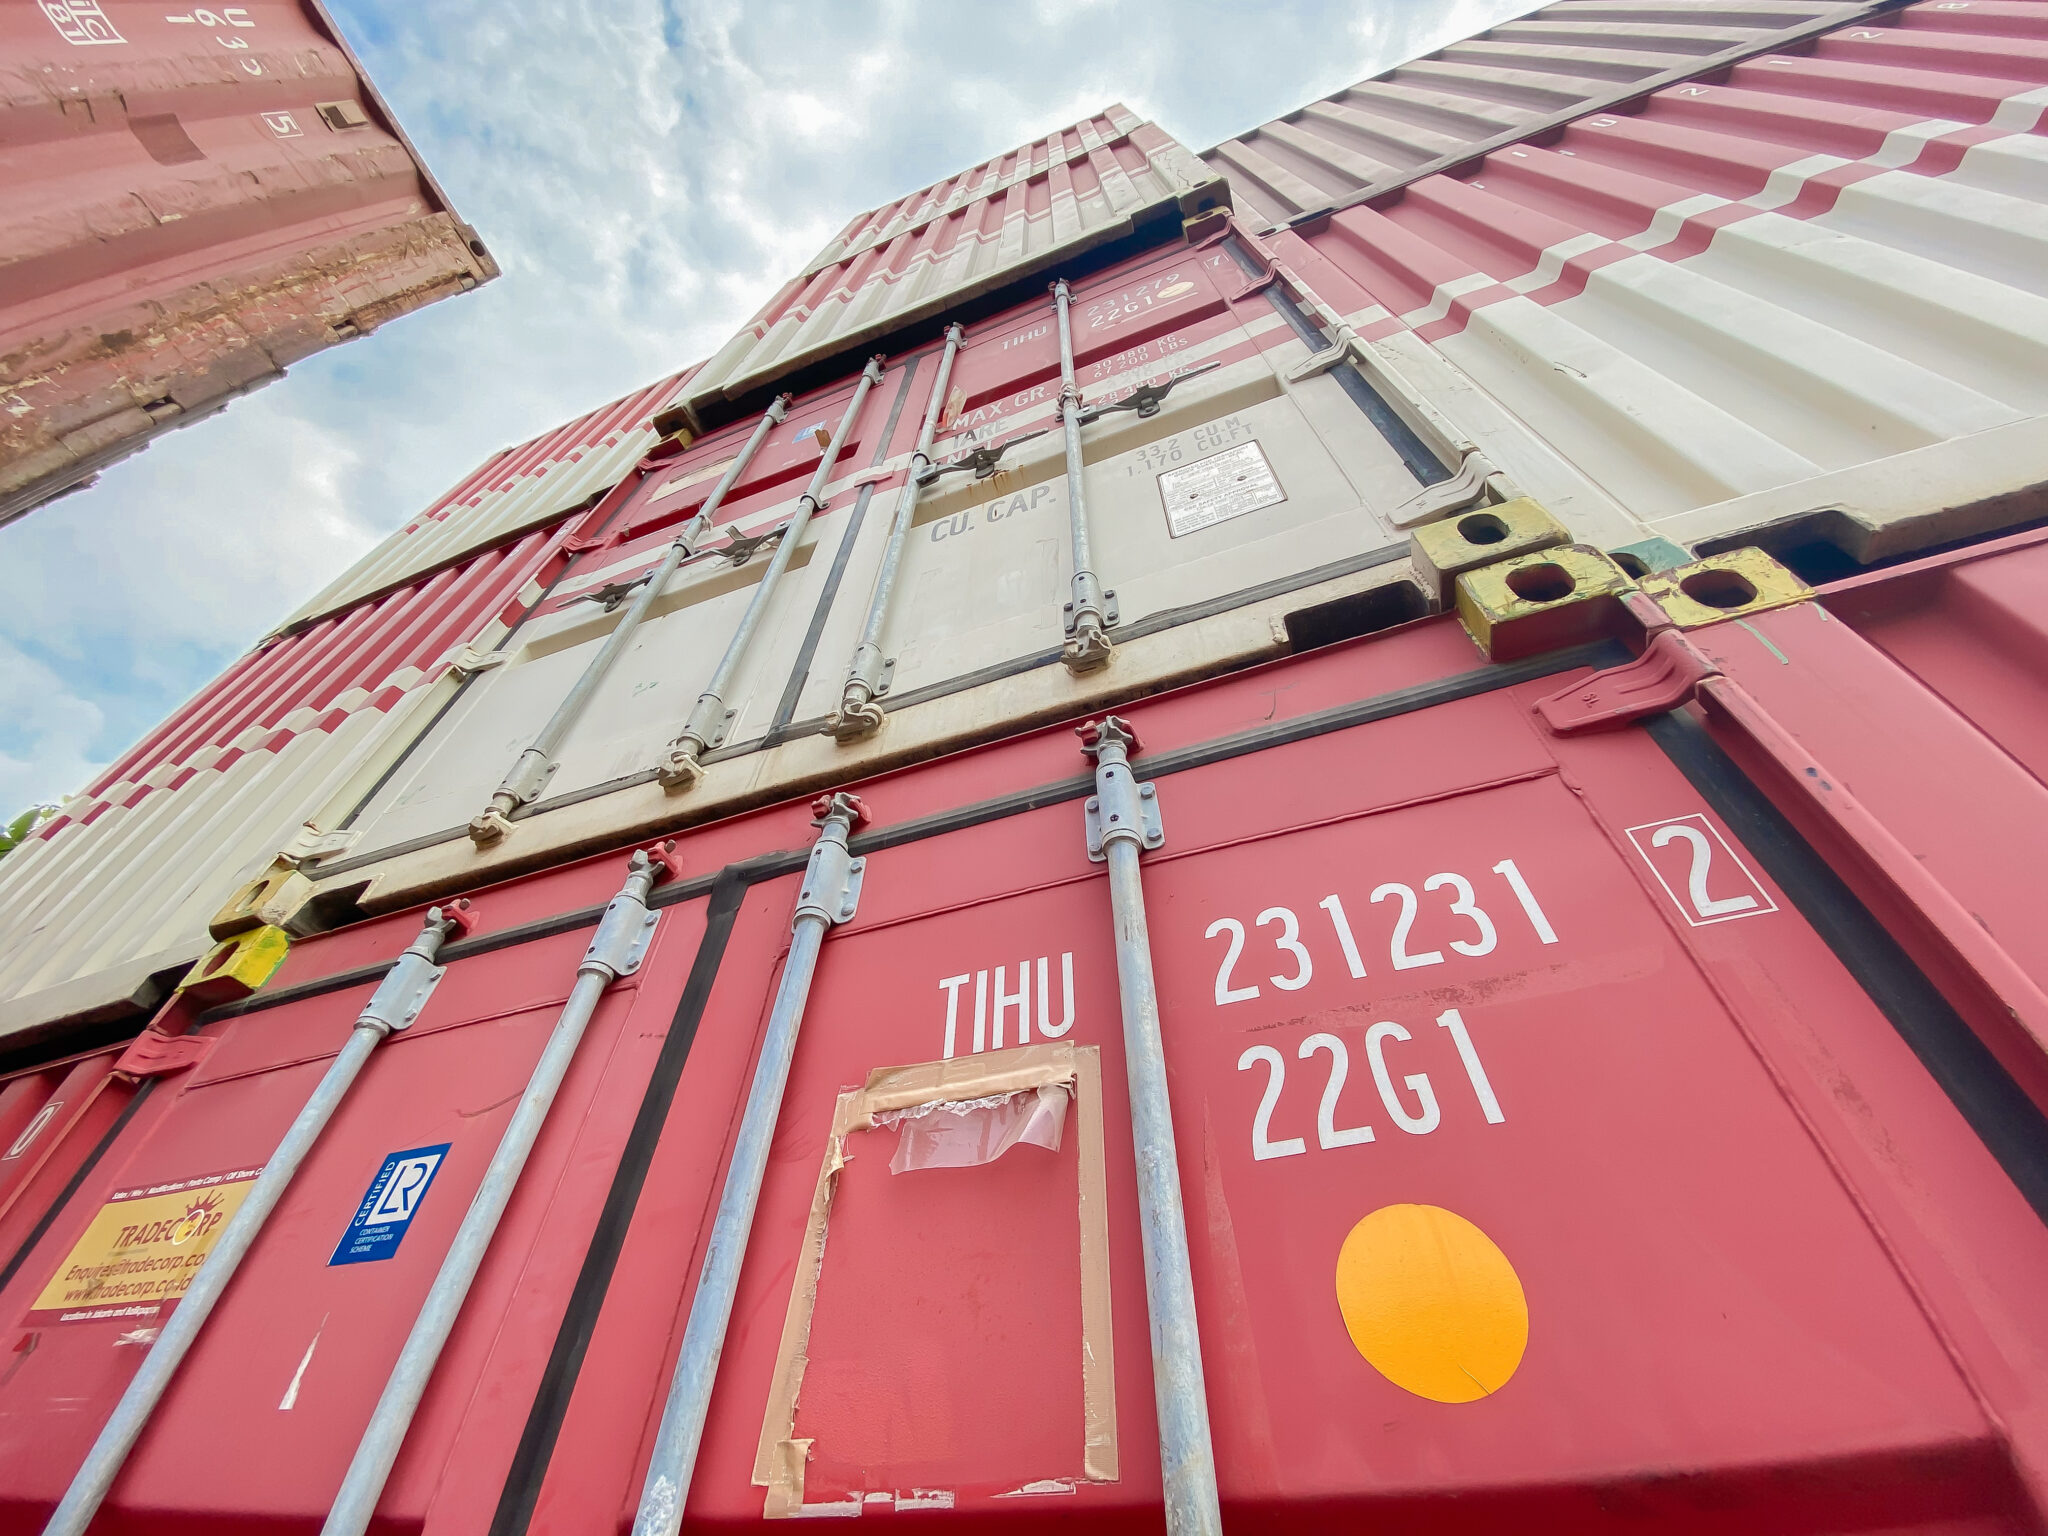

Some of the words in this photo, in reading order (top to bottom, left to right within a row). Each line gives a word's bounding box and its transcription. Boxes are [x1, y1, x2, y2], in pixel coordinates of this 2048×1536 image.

[264, 114, 300, 135] 5
[1086, 272, 1181, 318] 231279
[1090, 294, 1154, 329] 22G1
[1001, 325, 1048, 351] TIHU
[952, 400, 1011, 431] MAX.
[1013, 386, 1051, 408] GR.
[930, 511, 976, 543] CU.
[986, 485, 1057, 523] CAP.
[936, 951, 1076, 1060] TIHU
[1204, 858, 1561, 1008] 231231
[1646, 822, 1762, 919] 2
[1235, 1007, 1507, 1162] 22G1
[354, 1161, 396, 1227] CERTIFIED
[112, 1208, 224, 1250] TRADECORP
